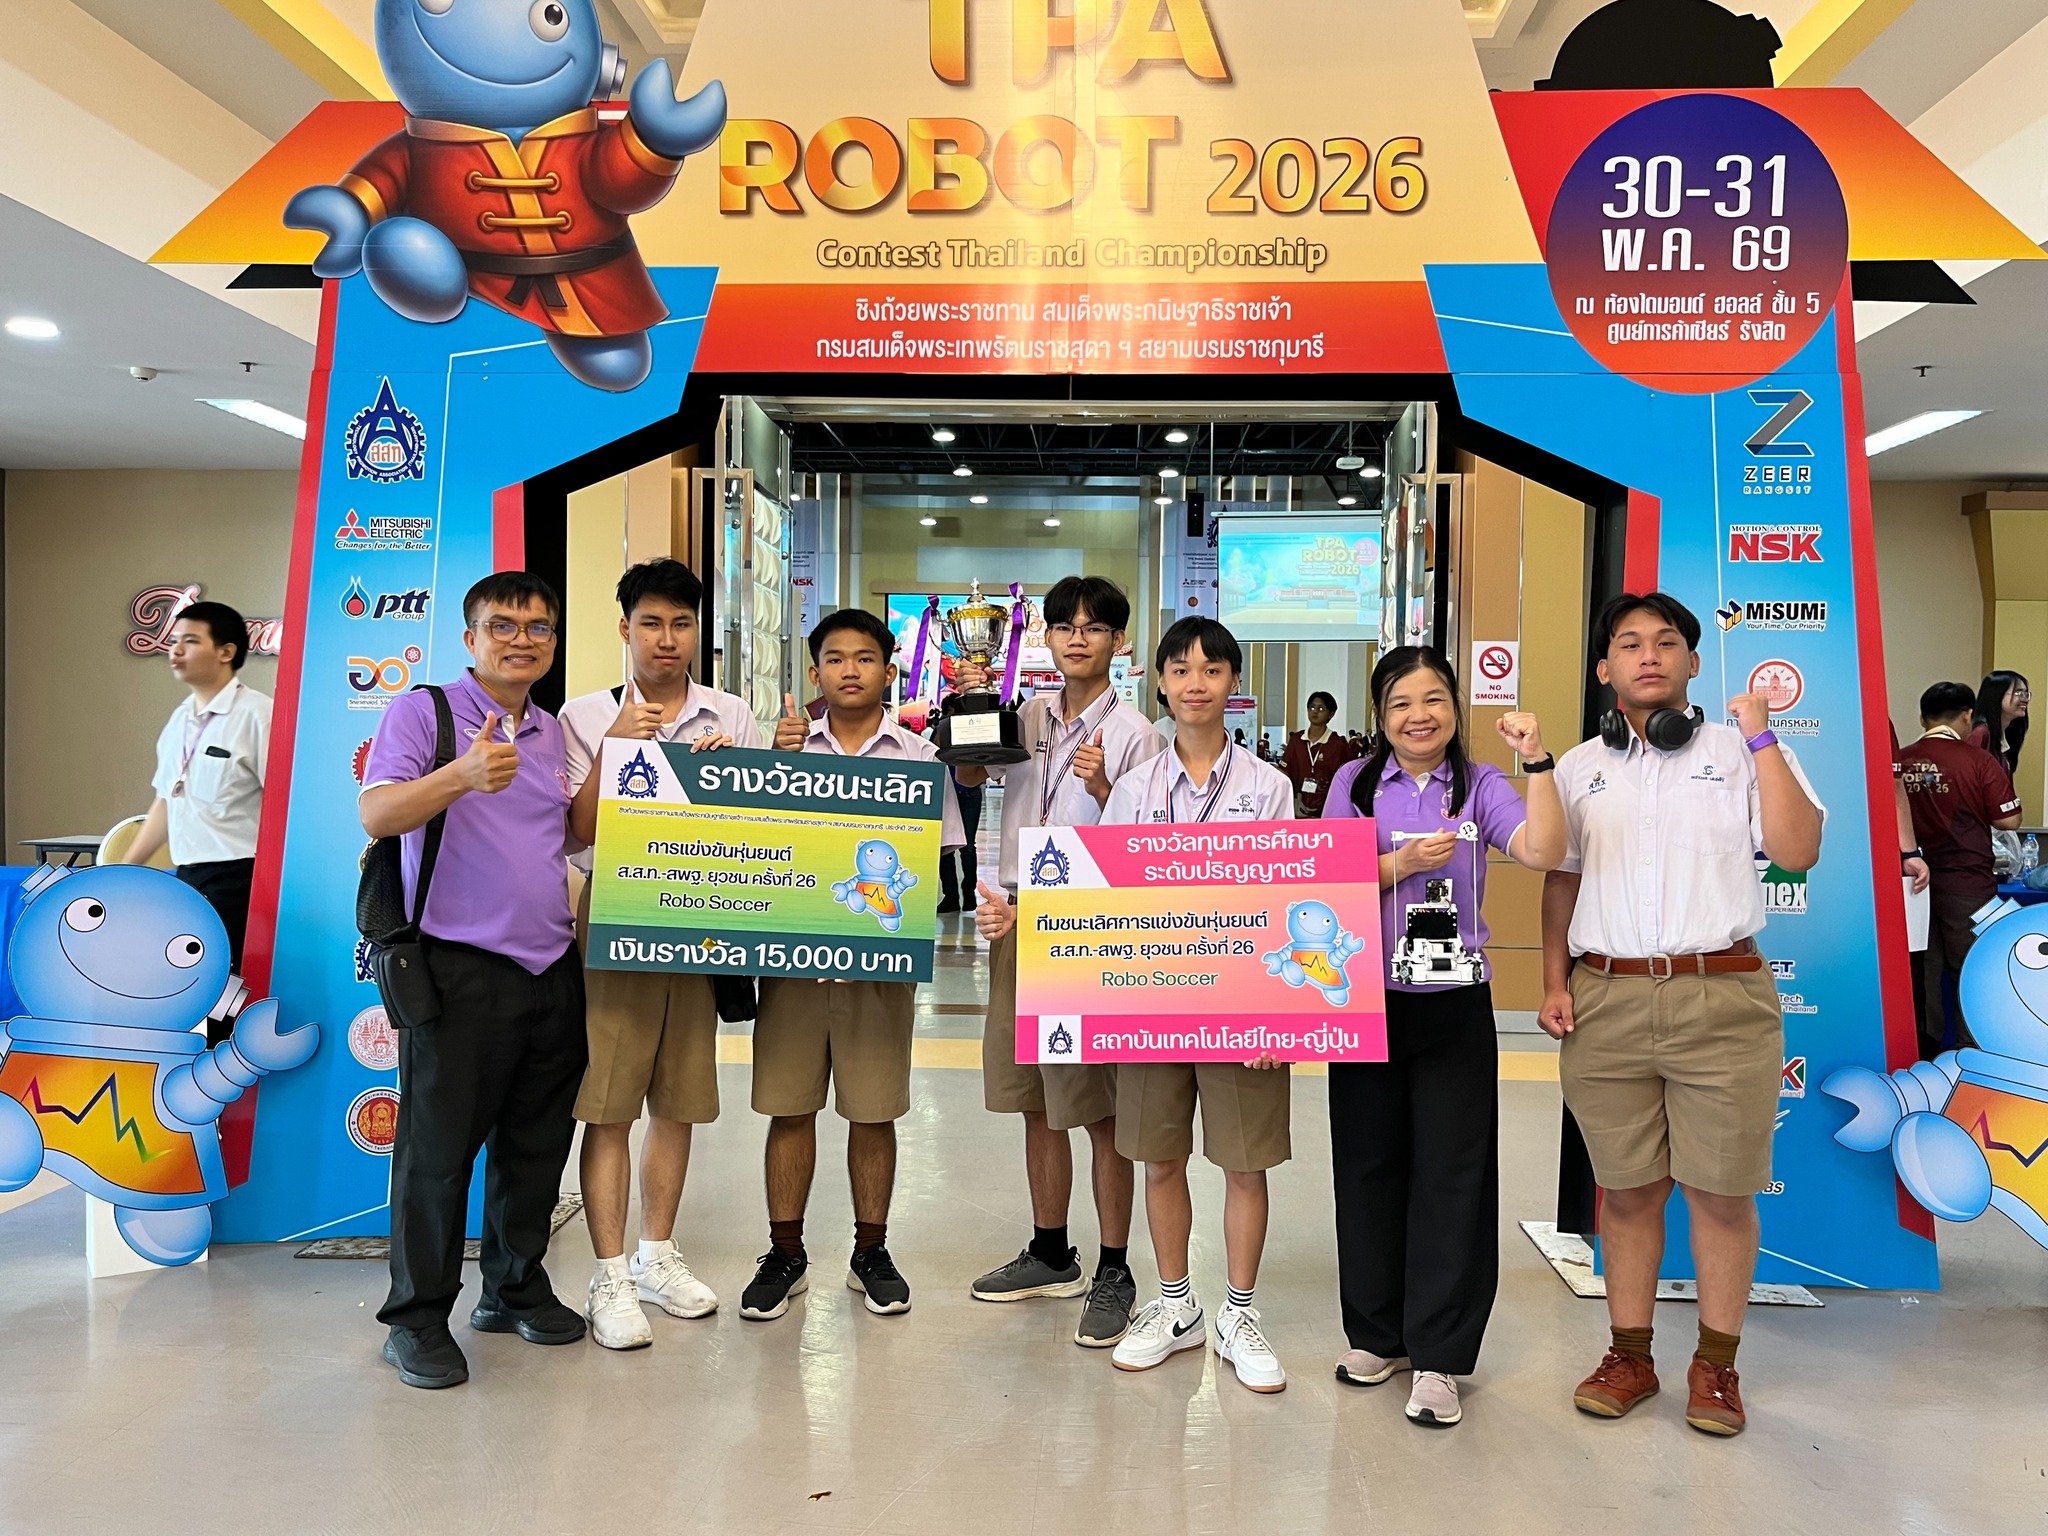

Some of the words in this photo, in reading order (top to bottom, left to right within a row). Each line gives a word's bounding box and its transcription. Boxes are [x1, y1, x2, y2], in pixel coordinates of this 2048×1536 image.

[719, 116, 1180, 215] ROBOT
[1208, 137, 1426, 213] 2026
[1602, 154, 1786, 218] 30-31
[817, 239, 940, 268] Contest
[947, 238, 1084, 268] Thailand
[1095, 238, 1327, 273] Championship
[1602, 228, 1704, 271] พ.ค.
[1732, 225, 1790, 271] 69
[856, 296, 1034, 322] ชิงถ้วยพระราชทาน
[1043, 295, 1291, 326] สมเด็จพระกนิษฐาธิราชเจ้า
[1576, 298, 1594, 315] ณ
[1605, 291, 1705, 315] ห้องไดมอนด์
[1715, 292, 1762, 315] ฮอลล์
[1772, 289, 1795, 314] ชั้น
[1806, 293, 1820, 314] 5
[1608, 320, 1730, 344] ศูนย์การค้าเซียร์
[1740, 320, 1786, 342] รังสิต
[816, 331, 1109, 365] กรมสมเด็จพระเทพรัตนราชสุดา
[1118, 339, 1131, 358] ฯ
[1139, 332, 1324, 366] สยามบรมราชกุมารี
[1745, 467, 1809, 481] ZEER
[1744, 486, 1811, 494] RANGSIT
[371, 518, 431, 528] MITSUBISHI
[371, 529, 423, 538] ELECTRIC
[336, 541, 371, 550] Changes
[374, 541, 387, 551] for
[390, 541, 402, 549] the
[405, 541, 431, 550] Better
[1302, 549, 1357, 562] ROBOT
[1730, 534, 1823, 561] NSK
[1331, 565, 1360, 575] 2026
[373, 589, 431, 618] ptt
[393, 612, 425, 621] Group
[1800, 623, 1824, 631] Priority
[699, 762, 933, 806] รางวัลชนะเลิศ
[647, 838, 793, 863] การแข่งขันหุ่นยนต์
[1127, 829, 1333, 856] รางวัลทุนการศึกษา
[617, 864, 705, 885] ส.ส.ท.-สพฐ.
[708, 869, 749, 887] ยุวชน
[752, 868, 793, 887] ครั้งที่
[795, 874, 816, 888] 26
[1144, 857, 1316, 884] ระดับปริญญาตรี
[659, 892, 705, 909] Robo
[709, 894, 772, 912] Soccer
[1037, 910, 1268, 936] ทีมชนะเลิศการแข่งขันหุ่นยนต์
[609, 937, 747, 967] เงินรางวัล
[754, 943, 853, 971] 15,000
[861, 951, 913, 973] บาท
[1050, 941, 1138, 961] ส.ส.ท.-สพฐ.
[1140, 942, 1182, 960] ยุวชน
[1186, 937, 1229, 956] ครั้งที่
[1233, 940, 1254, 955] 26
[1102, 971, 1148, 987] Robo
[1152, 971, 1218, 987] Soccer
[1092, 1023, 1359, 1054] สถาบันเทคโนโลยีไทย-ญี่ปุ่น
